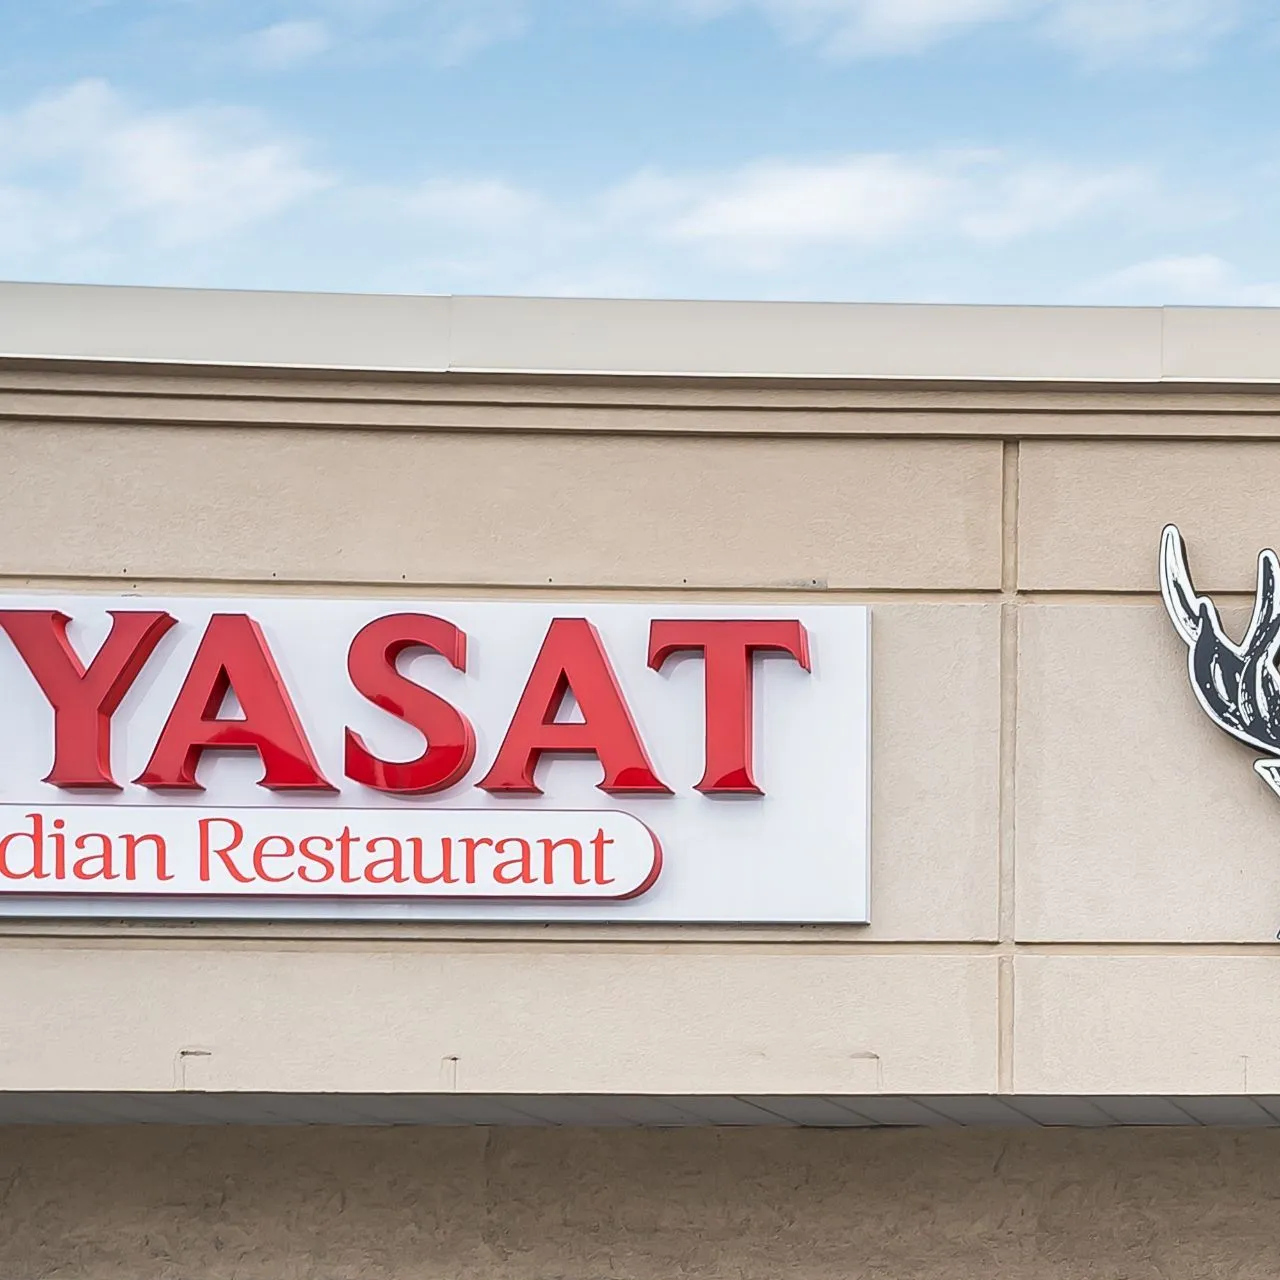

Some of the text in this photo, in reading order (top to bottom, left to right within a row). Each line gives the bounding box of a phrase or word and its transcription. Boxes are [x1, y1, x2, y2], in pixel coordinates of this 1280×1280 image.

[0, 609, 812, 797] YASAT
[0, 813, 615, 886] dian Restaurant
